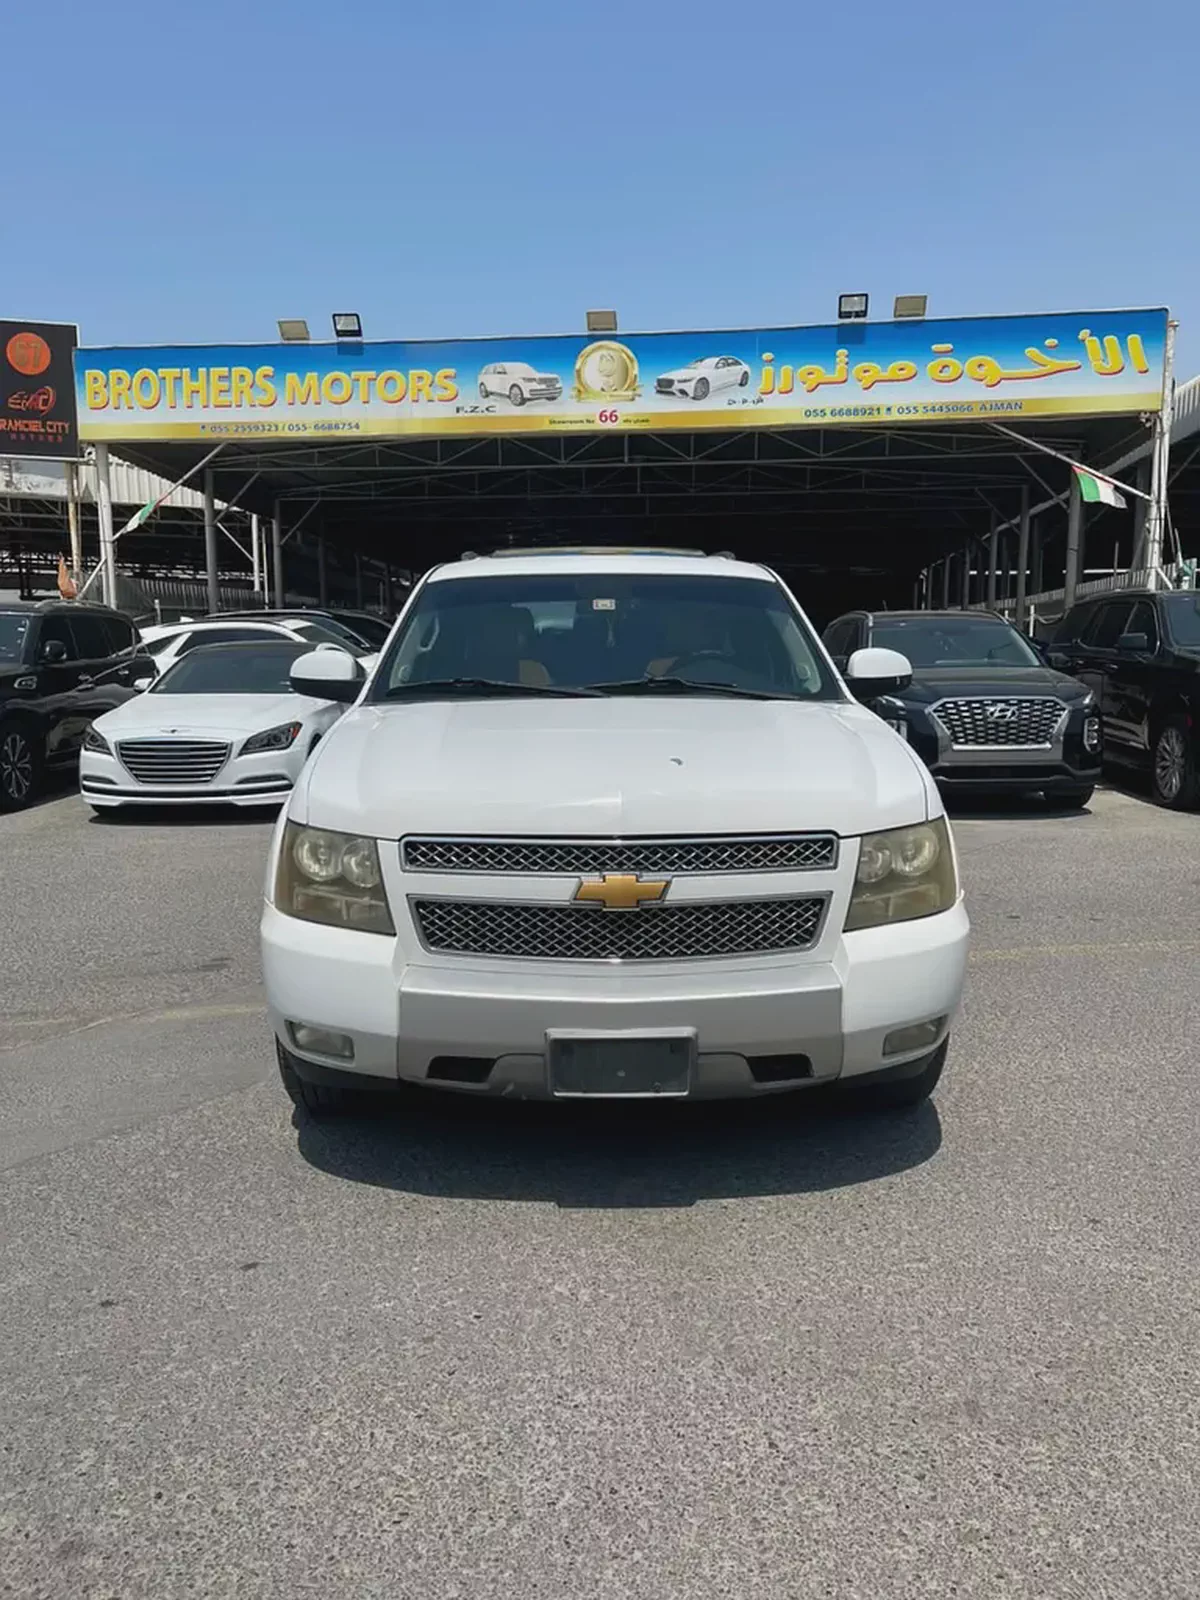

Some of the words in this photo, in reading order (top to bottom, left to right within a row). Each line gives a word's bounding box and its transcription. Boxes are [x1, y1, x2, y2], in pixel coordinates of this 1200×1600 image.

[84, 366, 278, 410] BROTHERS
[284, 368, 459, 406] MOTORS
[599, 409, 619, 423] 66
[804, 408, 827, 418] 055
[896, 405, 920, 415] 055
[979, 402, 1023, 413] AJMAN
[210, 424, 230, 433] 055
